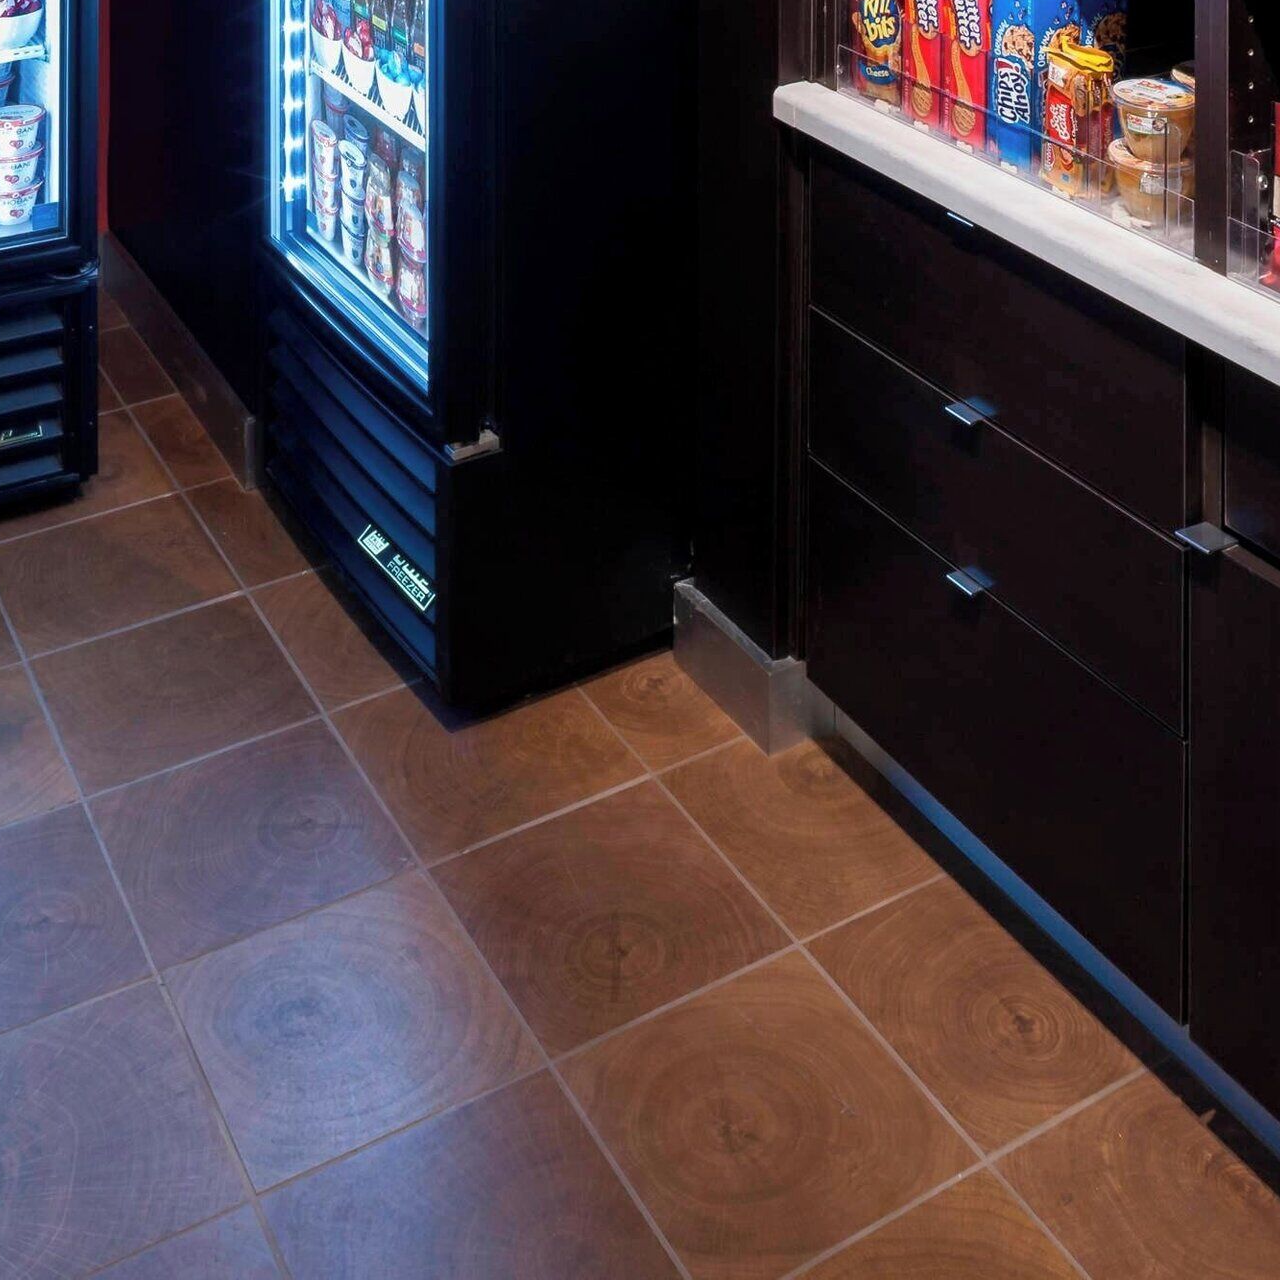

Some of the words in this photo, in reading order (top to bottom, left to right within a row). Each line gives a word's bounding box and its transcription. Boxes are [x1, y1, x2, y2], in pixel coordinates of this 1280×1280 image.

[864, 16, 895, 41] bits
[994, 19, 1009, 56] ORIGINAL
[865, 67, 889, 77] Cheese
[998, 69, 1017, 122] Chips
[1012, 62, 1031, 124] Ahoy!
[387, 561, 426, 602] FREEZER
